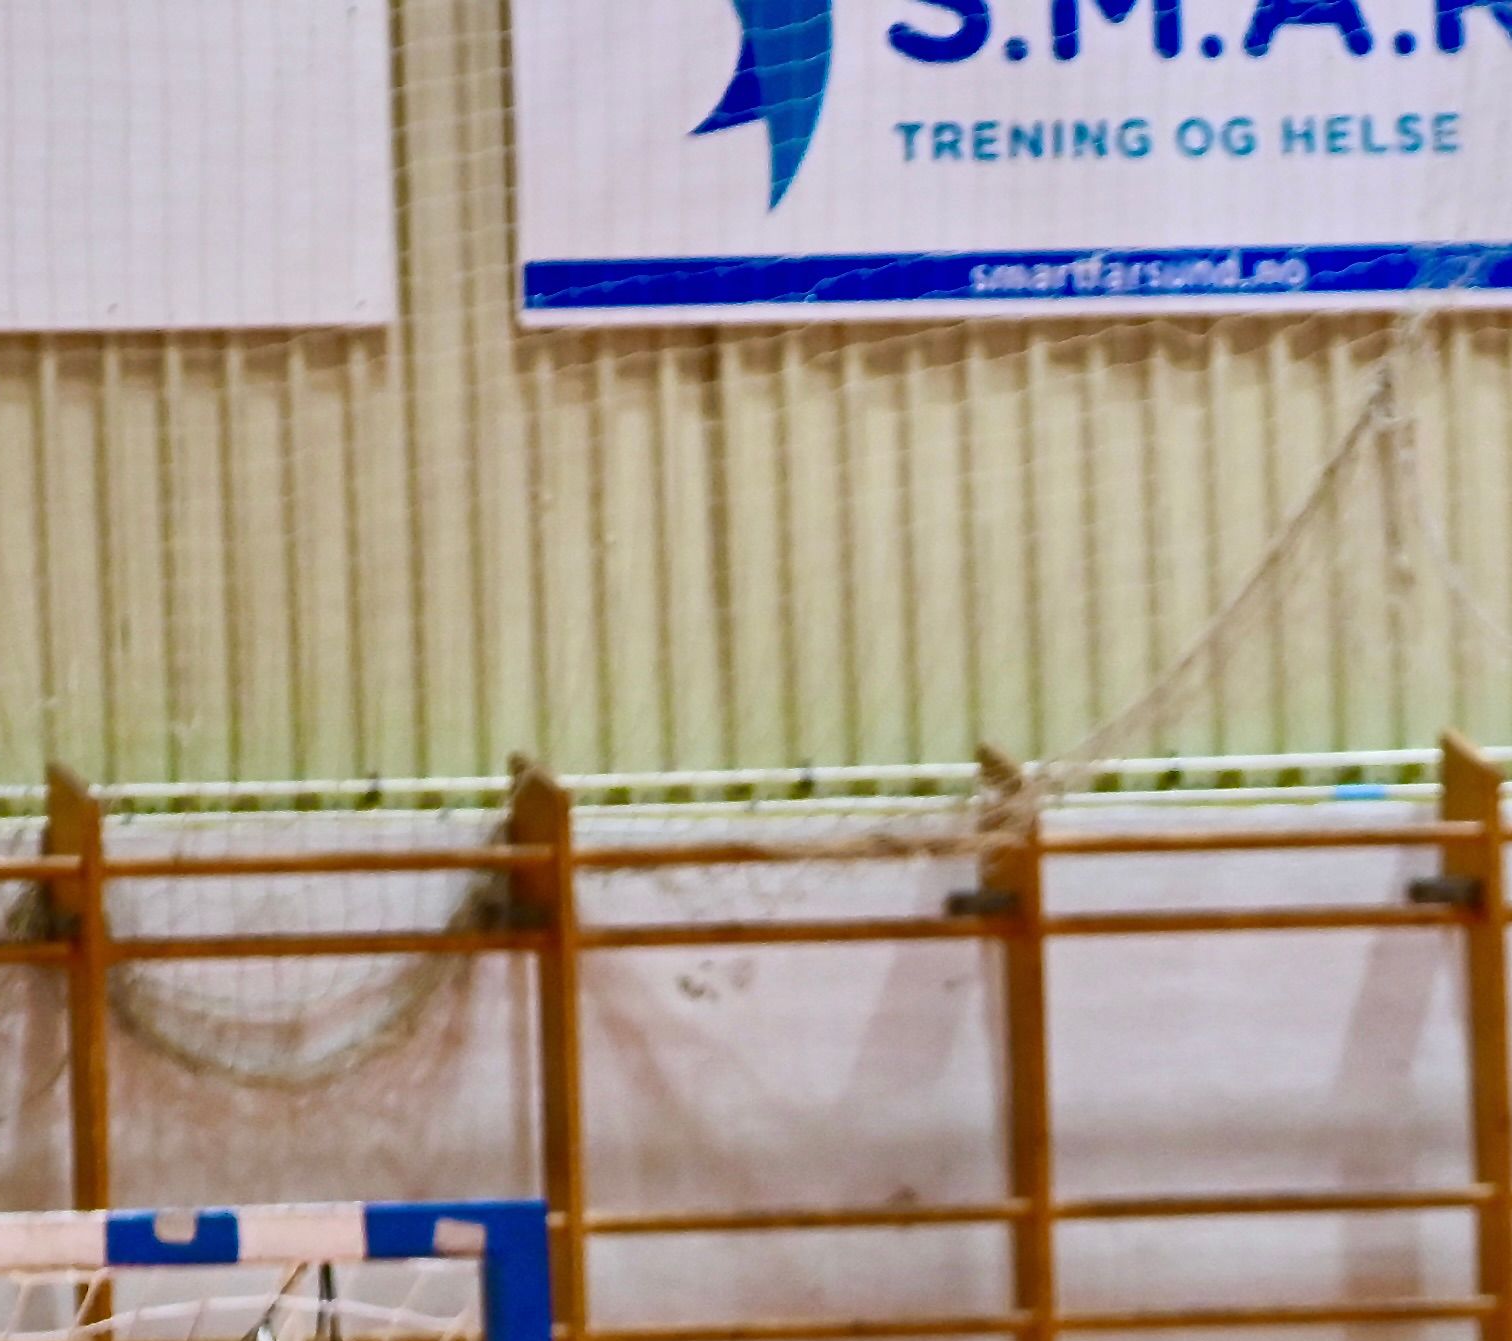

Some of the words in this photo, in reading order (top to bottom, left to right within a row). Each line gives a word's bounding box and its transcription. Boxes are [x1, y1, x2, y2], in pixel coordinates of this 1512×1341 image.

[894, 119, 1153, 162] TRENING
[1175, 116, 1258, 158] OG
[1281, 112, 1462, 155] HELSE
[968, 248, 1309, 292] smartfarsund.no
